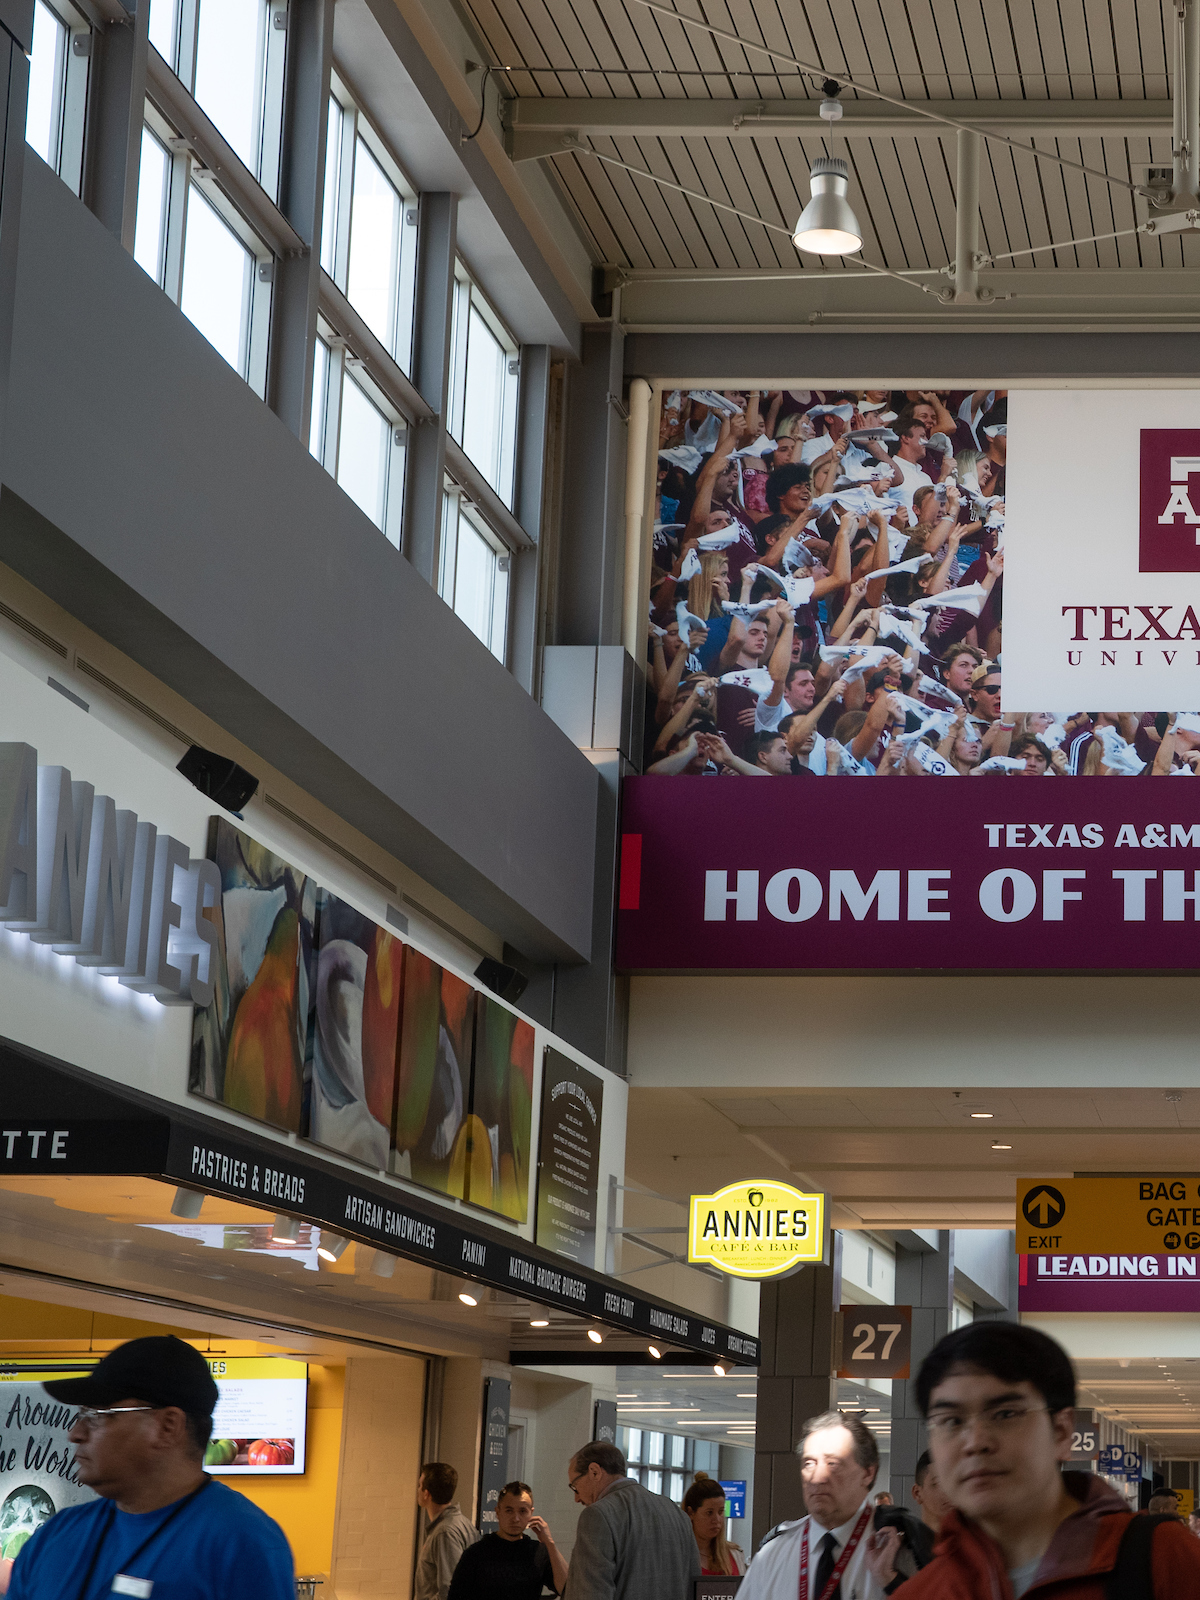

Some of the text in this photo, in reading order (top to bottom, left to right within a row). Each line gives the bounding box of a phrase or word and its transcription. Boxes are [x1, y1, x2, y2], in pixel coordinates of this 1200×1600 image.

[984, 823, 1104, 848] TEXAS
[0, 742, 222, 1007] ANNIES
[704, 867, 951, 923] HOME
[978, 867, 1086, 923] OF
[192, 1145, 305, 1203] PASTRIES & BREADS
[1139, 1182, 1186, 1201] BAG
[345, 1195, 436, 1249] ARTISAN SANDWICHES
[703, 1210, 808, 1238] ANNIES
[462, 1239, 487, 1266] PANINI
[711, 1241, 799, 1252] CAFÉ & BAR
[1029, 1236, 1062, 1248] EXIT
[508, 1256, 587, 1301] NATURAL BRIOCHE BURGERS
[1038, 1256, 1158, 1276] LEADING
[1168, 1256, 1196, 1276] IN
[604, 1292, 634, 1318] FRESH FRUIT
[650, 1309, 689, 1337] HANDMADE SALADS
[702, 1327, 716, 1344] JUICES
[728, 1335, 757, 1357] ORGANIC COFFEES
[852, 1323, 902, 1360] 27
[208, 1362, 226, 1374] IES
[1070, 1432, 1095, 1452] 25
[734, 1502, 740, 1511] 1
